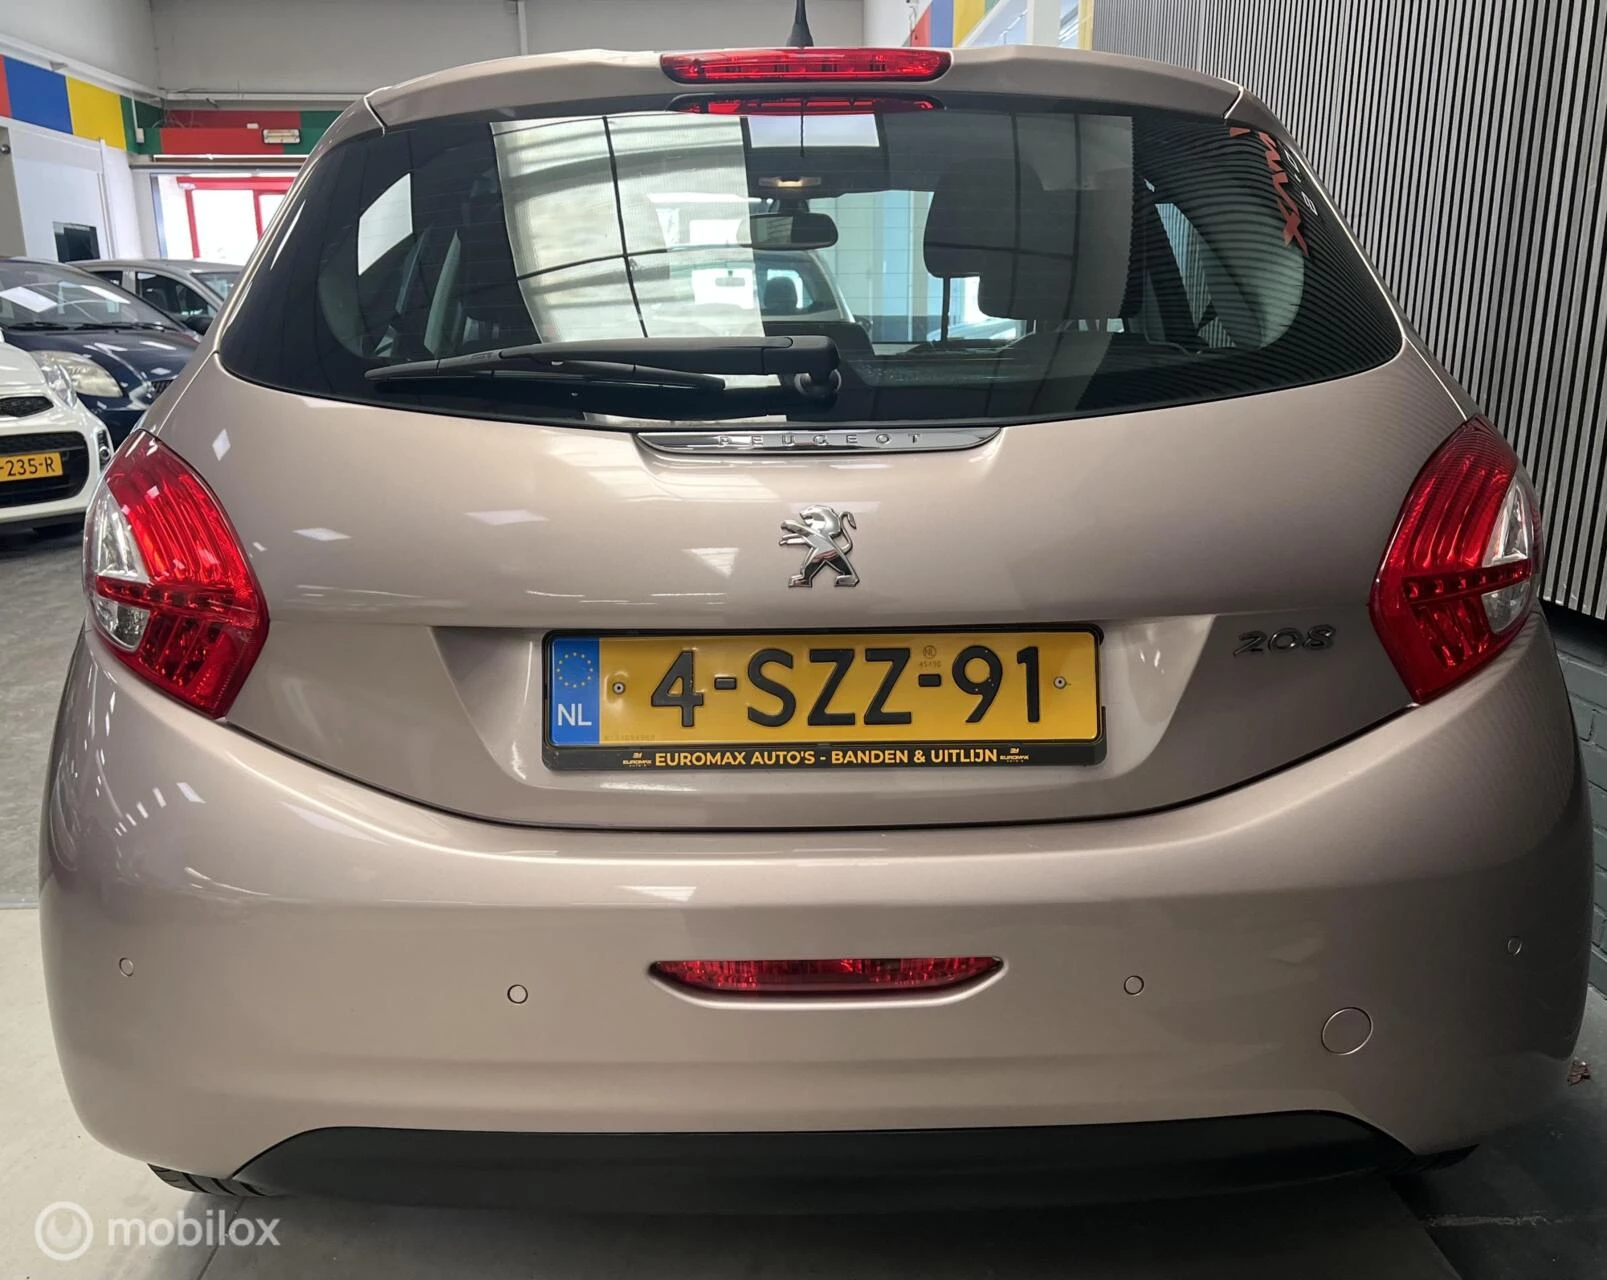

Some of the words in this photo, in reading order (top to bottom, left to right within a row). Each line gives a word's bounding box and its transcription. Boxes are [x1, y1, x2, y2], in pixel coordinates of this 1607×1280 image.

[719, 433, 922, 446] PEUGEOT
[1232, 623, 1336, 657] 208
[651, 645, 1040, 727] 4-SZZ-91
[557, 703, 592, 726] NL
[655, 751, 745, 766] EUROMAX
[750, 750, 816, 765] AUTO'S
[831, 750, 908, 764] BANDEN
[913, 749, 926, 763] &
[930, 748, 998, 763] UITLIJN
